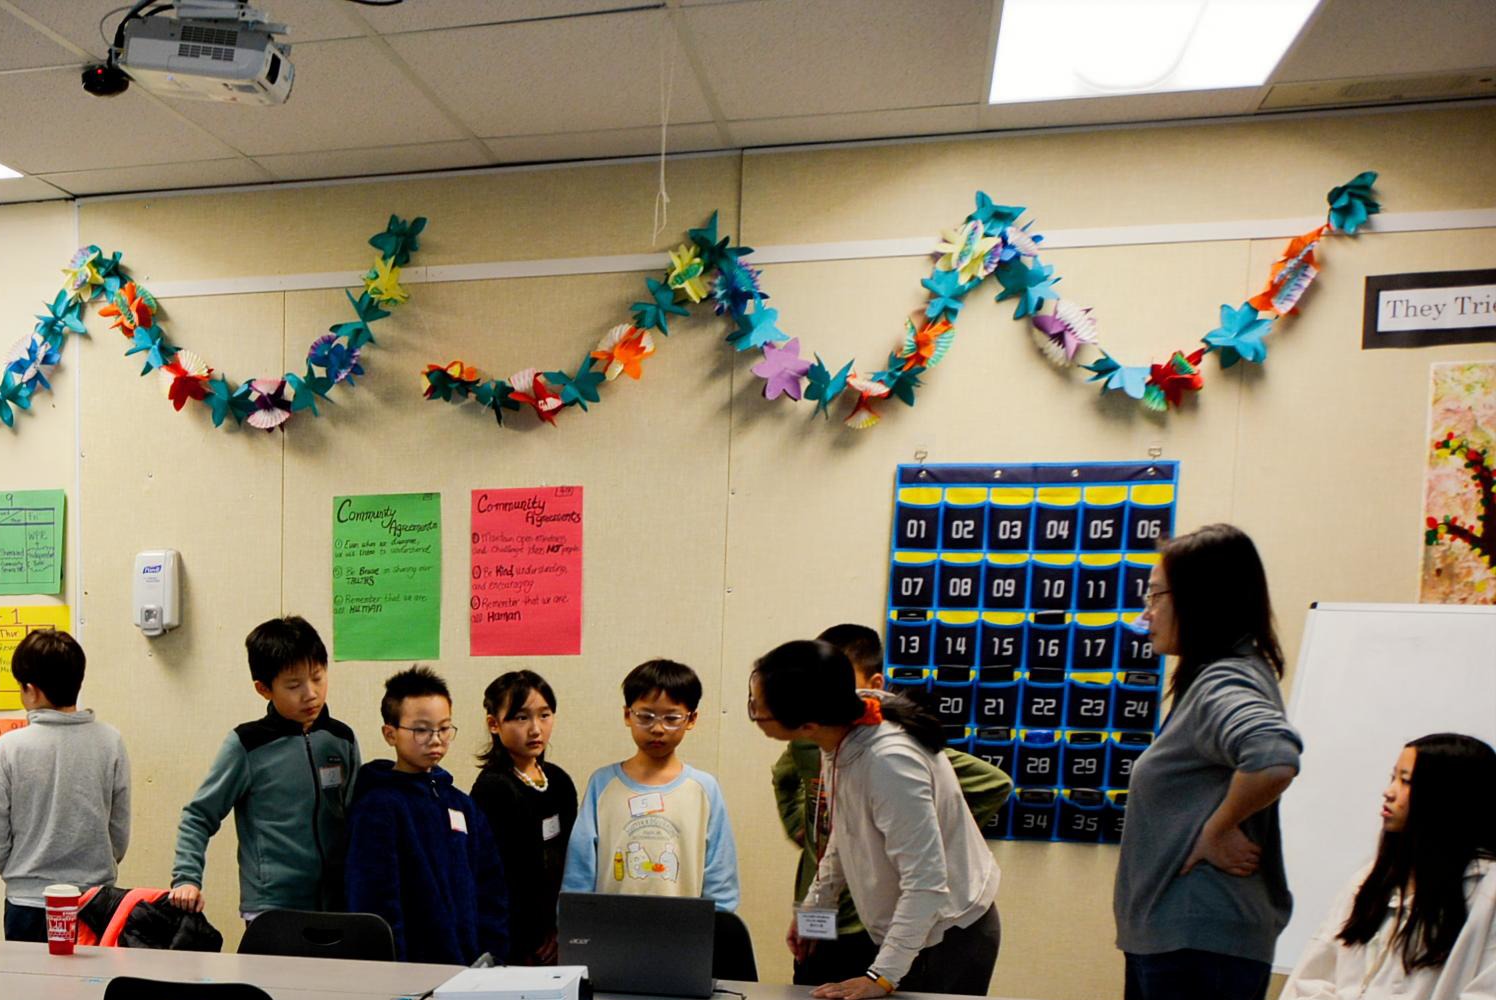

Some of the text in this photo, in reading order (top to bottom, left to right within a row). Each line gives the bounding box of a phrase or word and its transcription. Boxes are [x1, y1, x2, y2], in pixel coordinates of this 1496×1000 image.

[1386, 299, 1446, 320] They
[6, 493, 14, 507] 9
[477, 493, 546, 516] Community
[337, 499, 396, 528] Community
[906, 519, 1161, 539] 01 02 03 04 05 06
[547, 544, 563, 554] NOT
[359, 566, 380, 576] Brave
[901, 577, 924, 596] 07
[949, 577, 973, 596] 08
[992, 578, 1016, 598] 09
[1042, 579, 1066, 599] 10
[1086, 580, 1107, 599] 11
[346, 593, 382, 604] Remember
[384, 592, 401, 602] that
[481, 597, 521, 611] Remember
[11, 608, 23, 625] 1
[487, 610, 522, 622] Human
[899, 635, 1153, 660] 13 14 15 16 17 18
[939, 697, 1149, 718] 20 21 22 23 24
[1026, 757, 1051, 774] 28
[1072, 758, 1097, 775] 29
[1119, 758, 1134, 775] 3
[1023, 813, 1049, 829] 34
[1072, 814, 1099, 832] 35
[1114, 817, 1126, 832] 3
